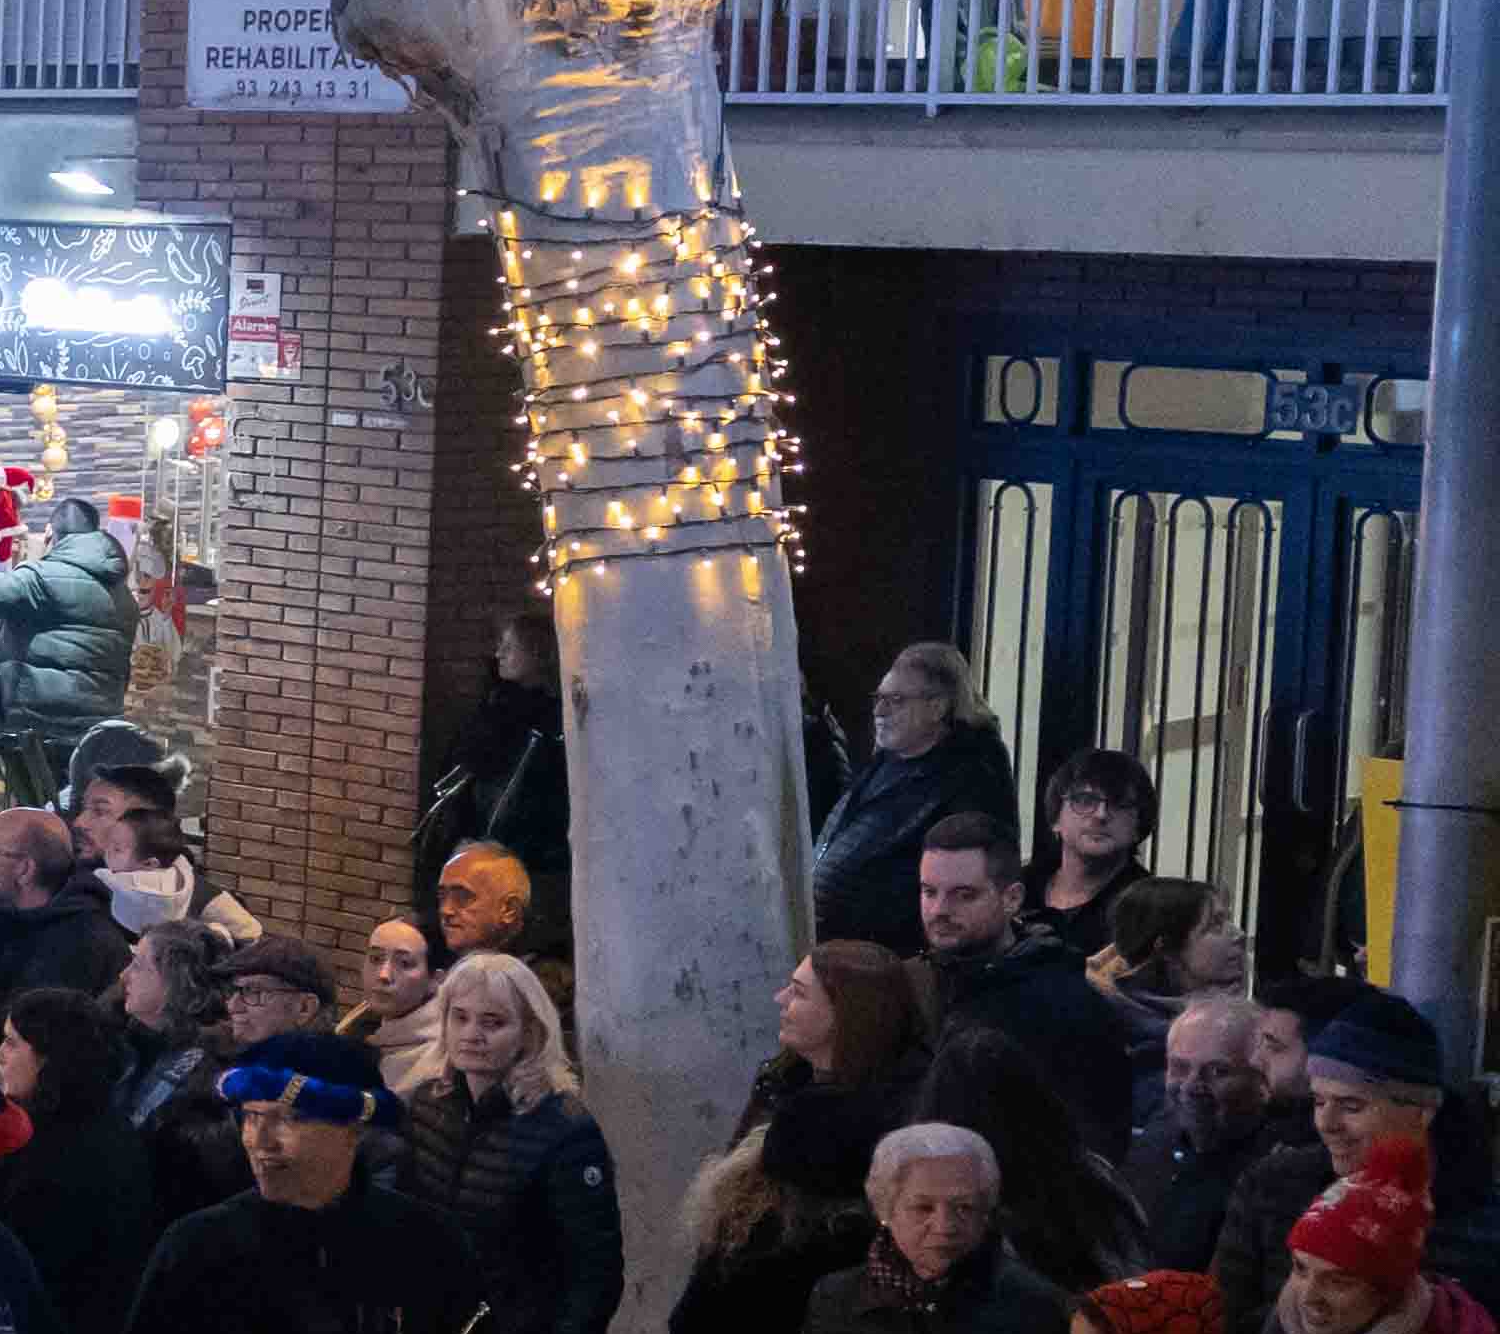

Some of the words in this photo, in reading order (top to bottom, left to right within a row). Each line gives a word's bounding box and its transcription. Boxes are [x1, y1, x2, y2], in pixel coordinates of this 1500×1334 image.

[236, 80, 258, 98] 93
[268, 79, 301, 99] 243
[315, 79, 336, 99] 13
[349, 79, 370, 99] 31
